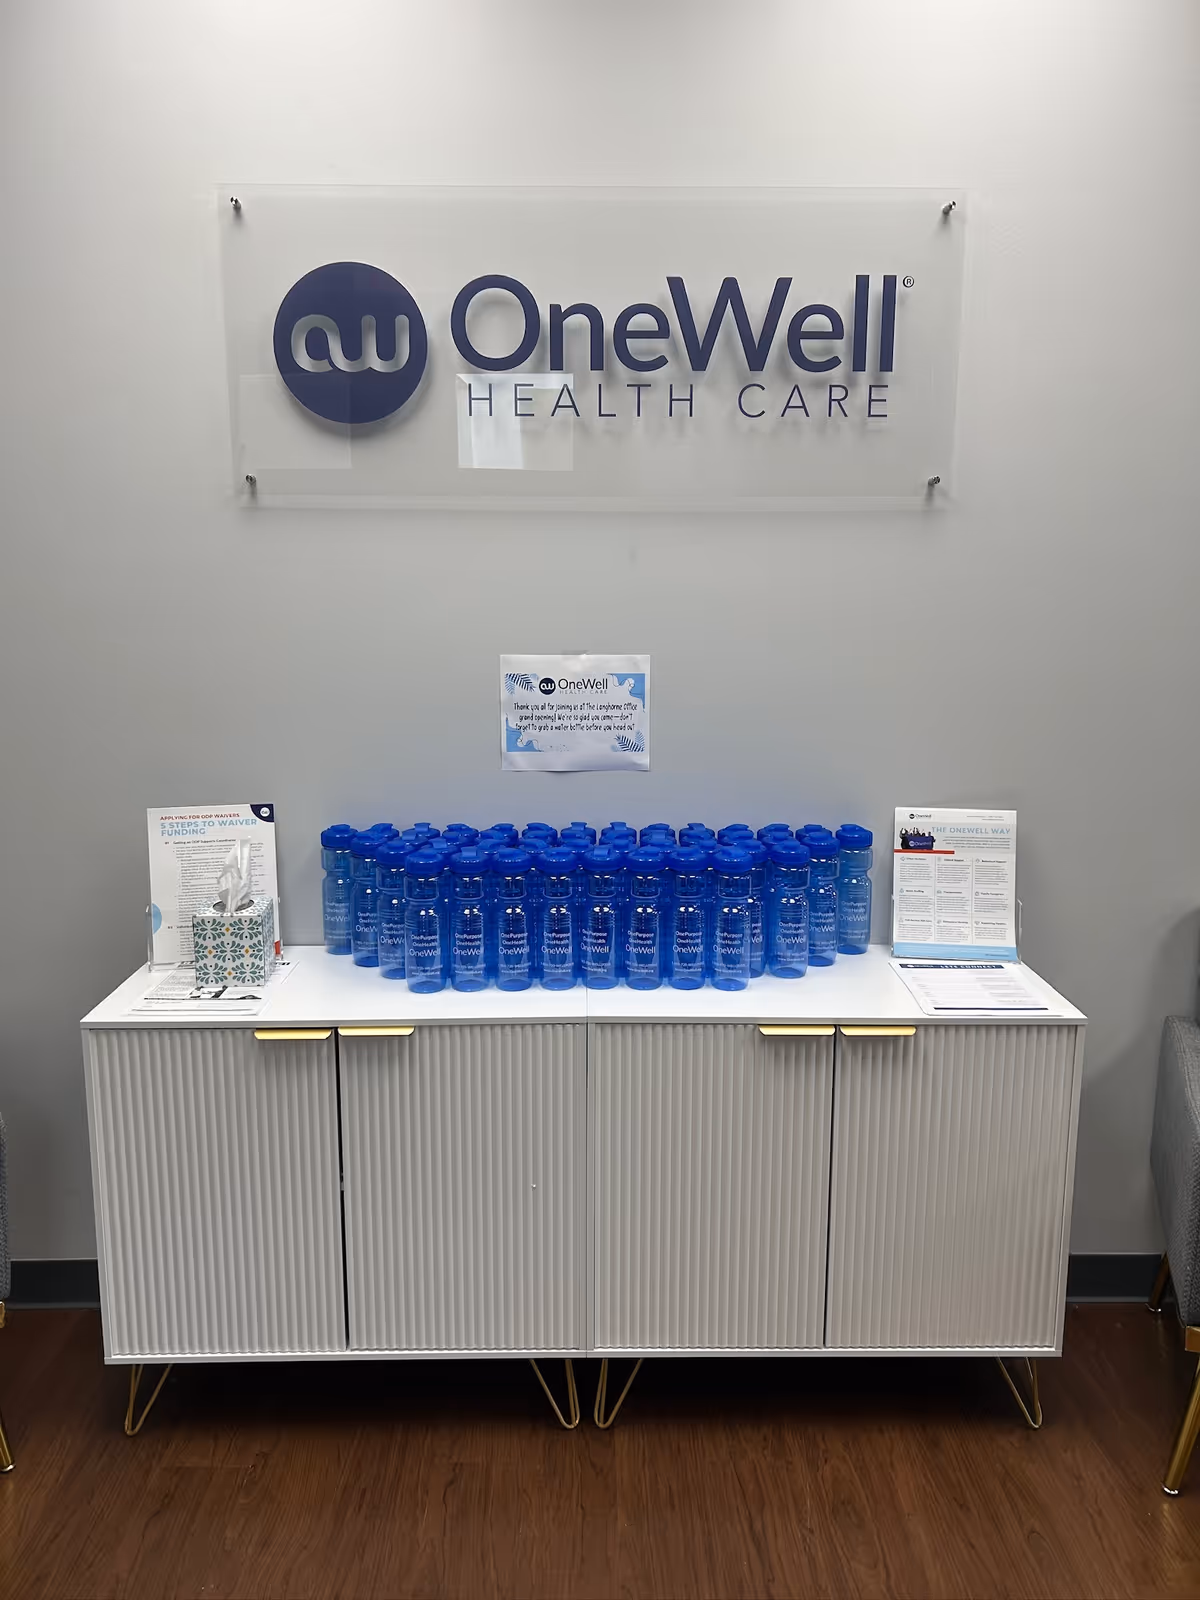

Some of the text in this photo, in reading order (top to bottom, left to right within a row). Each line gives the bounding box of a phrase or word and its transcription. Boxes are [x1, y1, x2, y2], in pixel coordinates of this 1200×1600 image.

[467, 383, 890, 419] HEALTH CARE
[558, 678, 608, 690] OneWell
[555, 703, 572, 712] joining
[519, 714, 534, 722] grand
[580, 714, 590, 722] glad
[515, 724, 531, 732] forget
[538, 724, 550, 732] grab
[168, 821, 199, 829] STEPS
[217, 818, 257, 826] WAIVER
[161, 828, 206, 836] FUNDING
[776, 935, 806, 944] OneWell
[409, 948, 441, 957] OneWell
[499, 946, 529, 955] OneWell
[542, 946, 572, 954] OneWell
[581, 942, 609, 954] OneWell
[626, 944, 656, 954] OneWell
[673, 945, 703, 953] OneWell
[713, 945, 744, 954] OneWell
